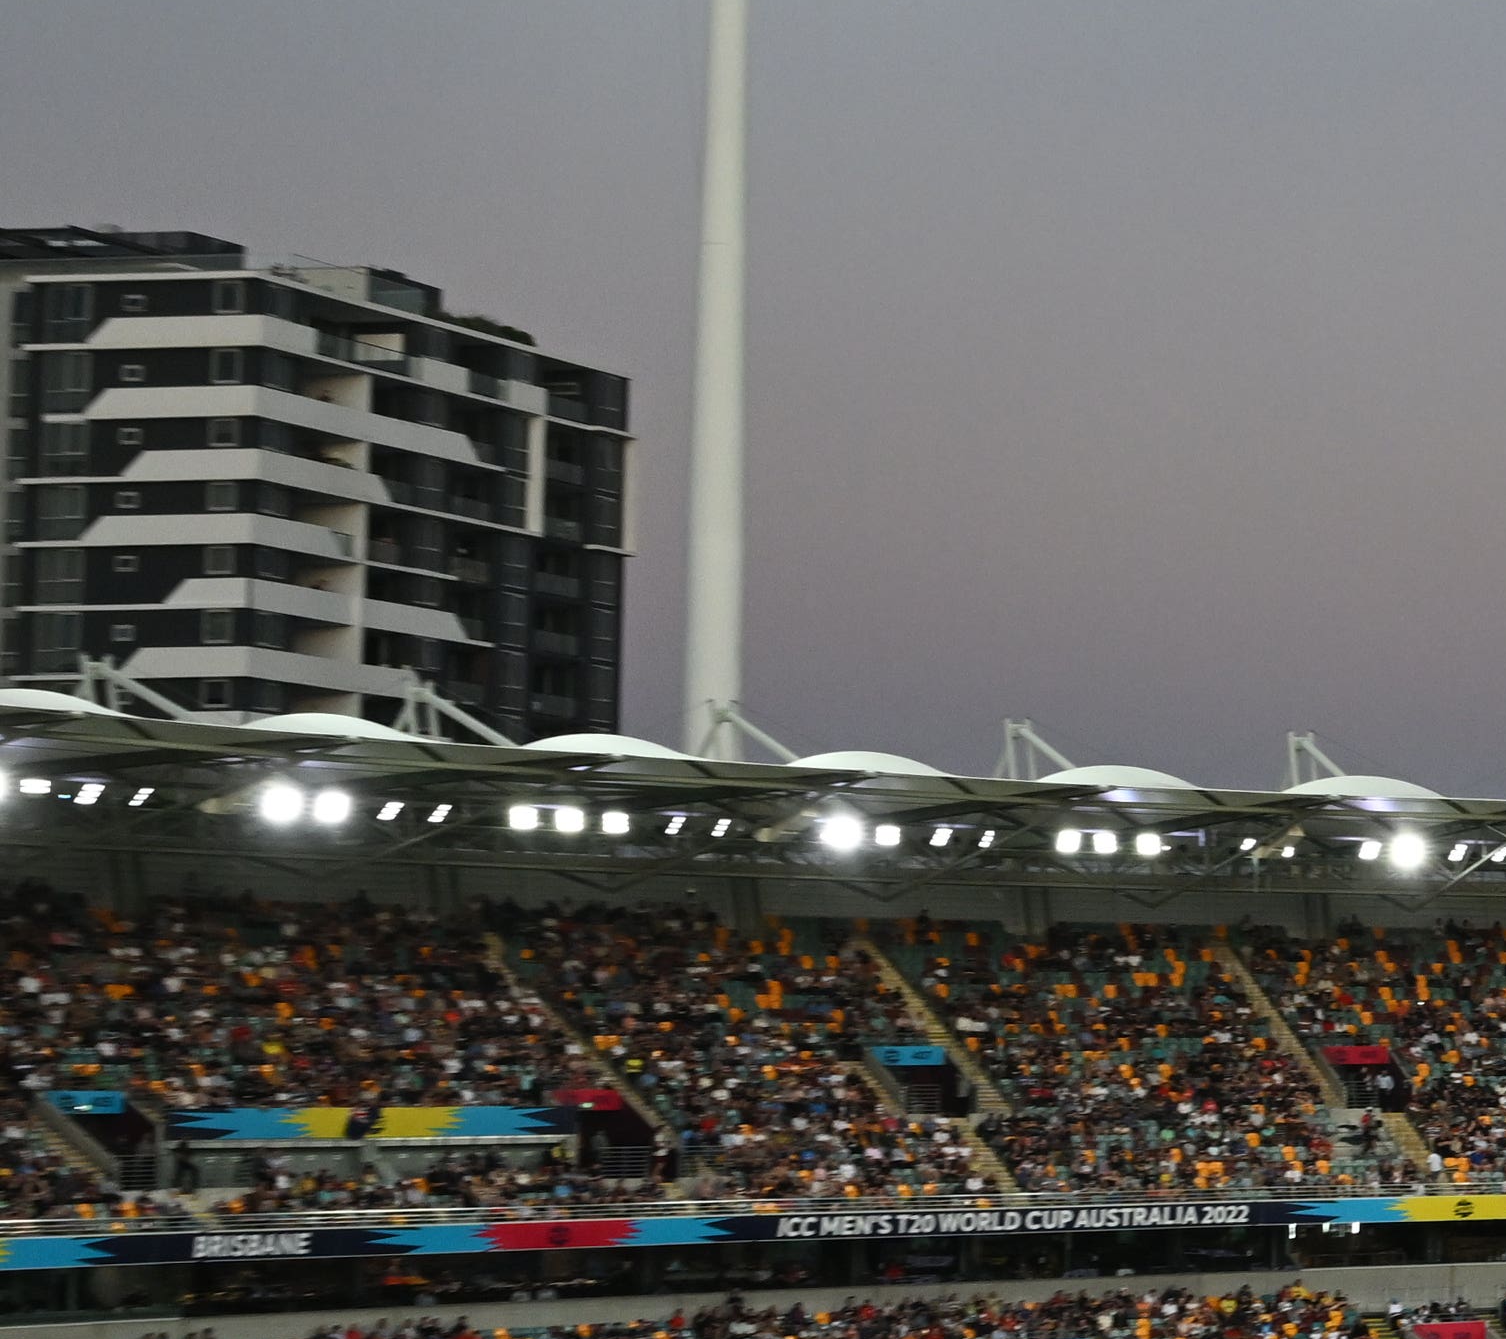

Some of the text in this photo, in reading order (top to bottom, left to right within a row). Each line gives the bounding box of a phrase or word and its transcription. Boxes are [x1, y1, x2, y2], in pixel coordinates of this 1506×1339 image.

[777, 1205, 1250, 1238] ICC MEN'S T20 WORLD CUP AUSTRALIA 2022
[192, 1233, 313, 1259] BRISBANE
